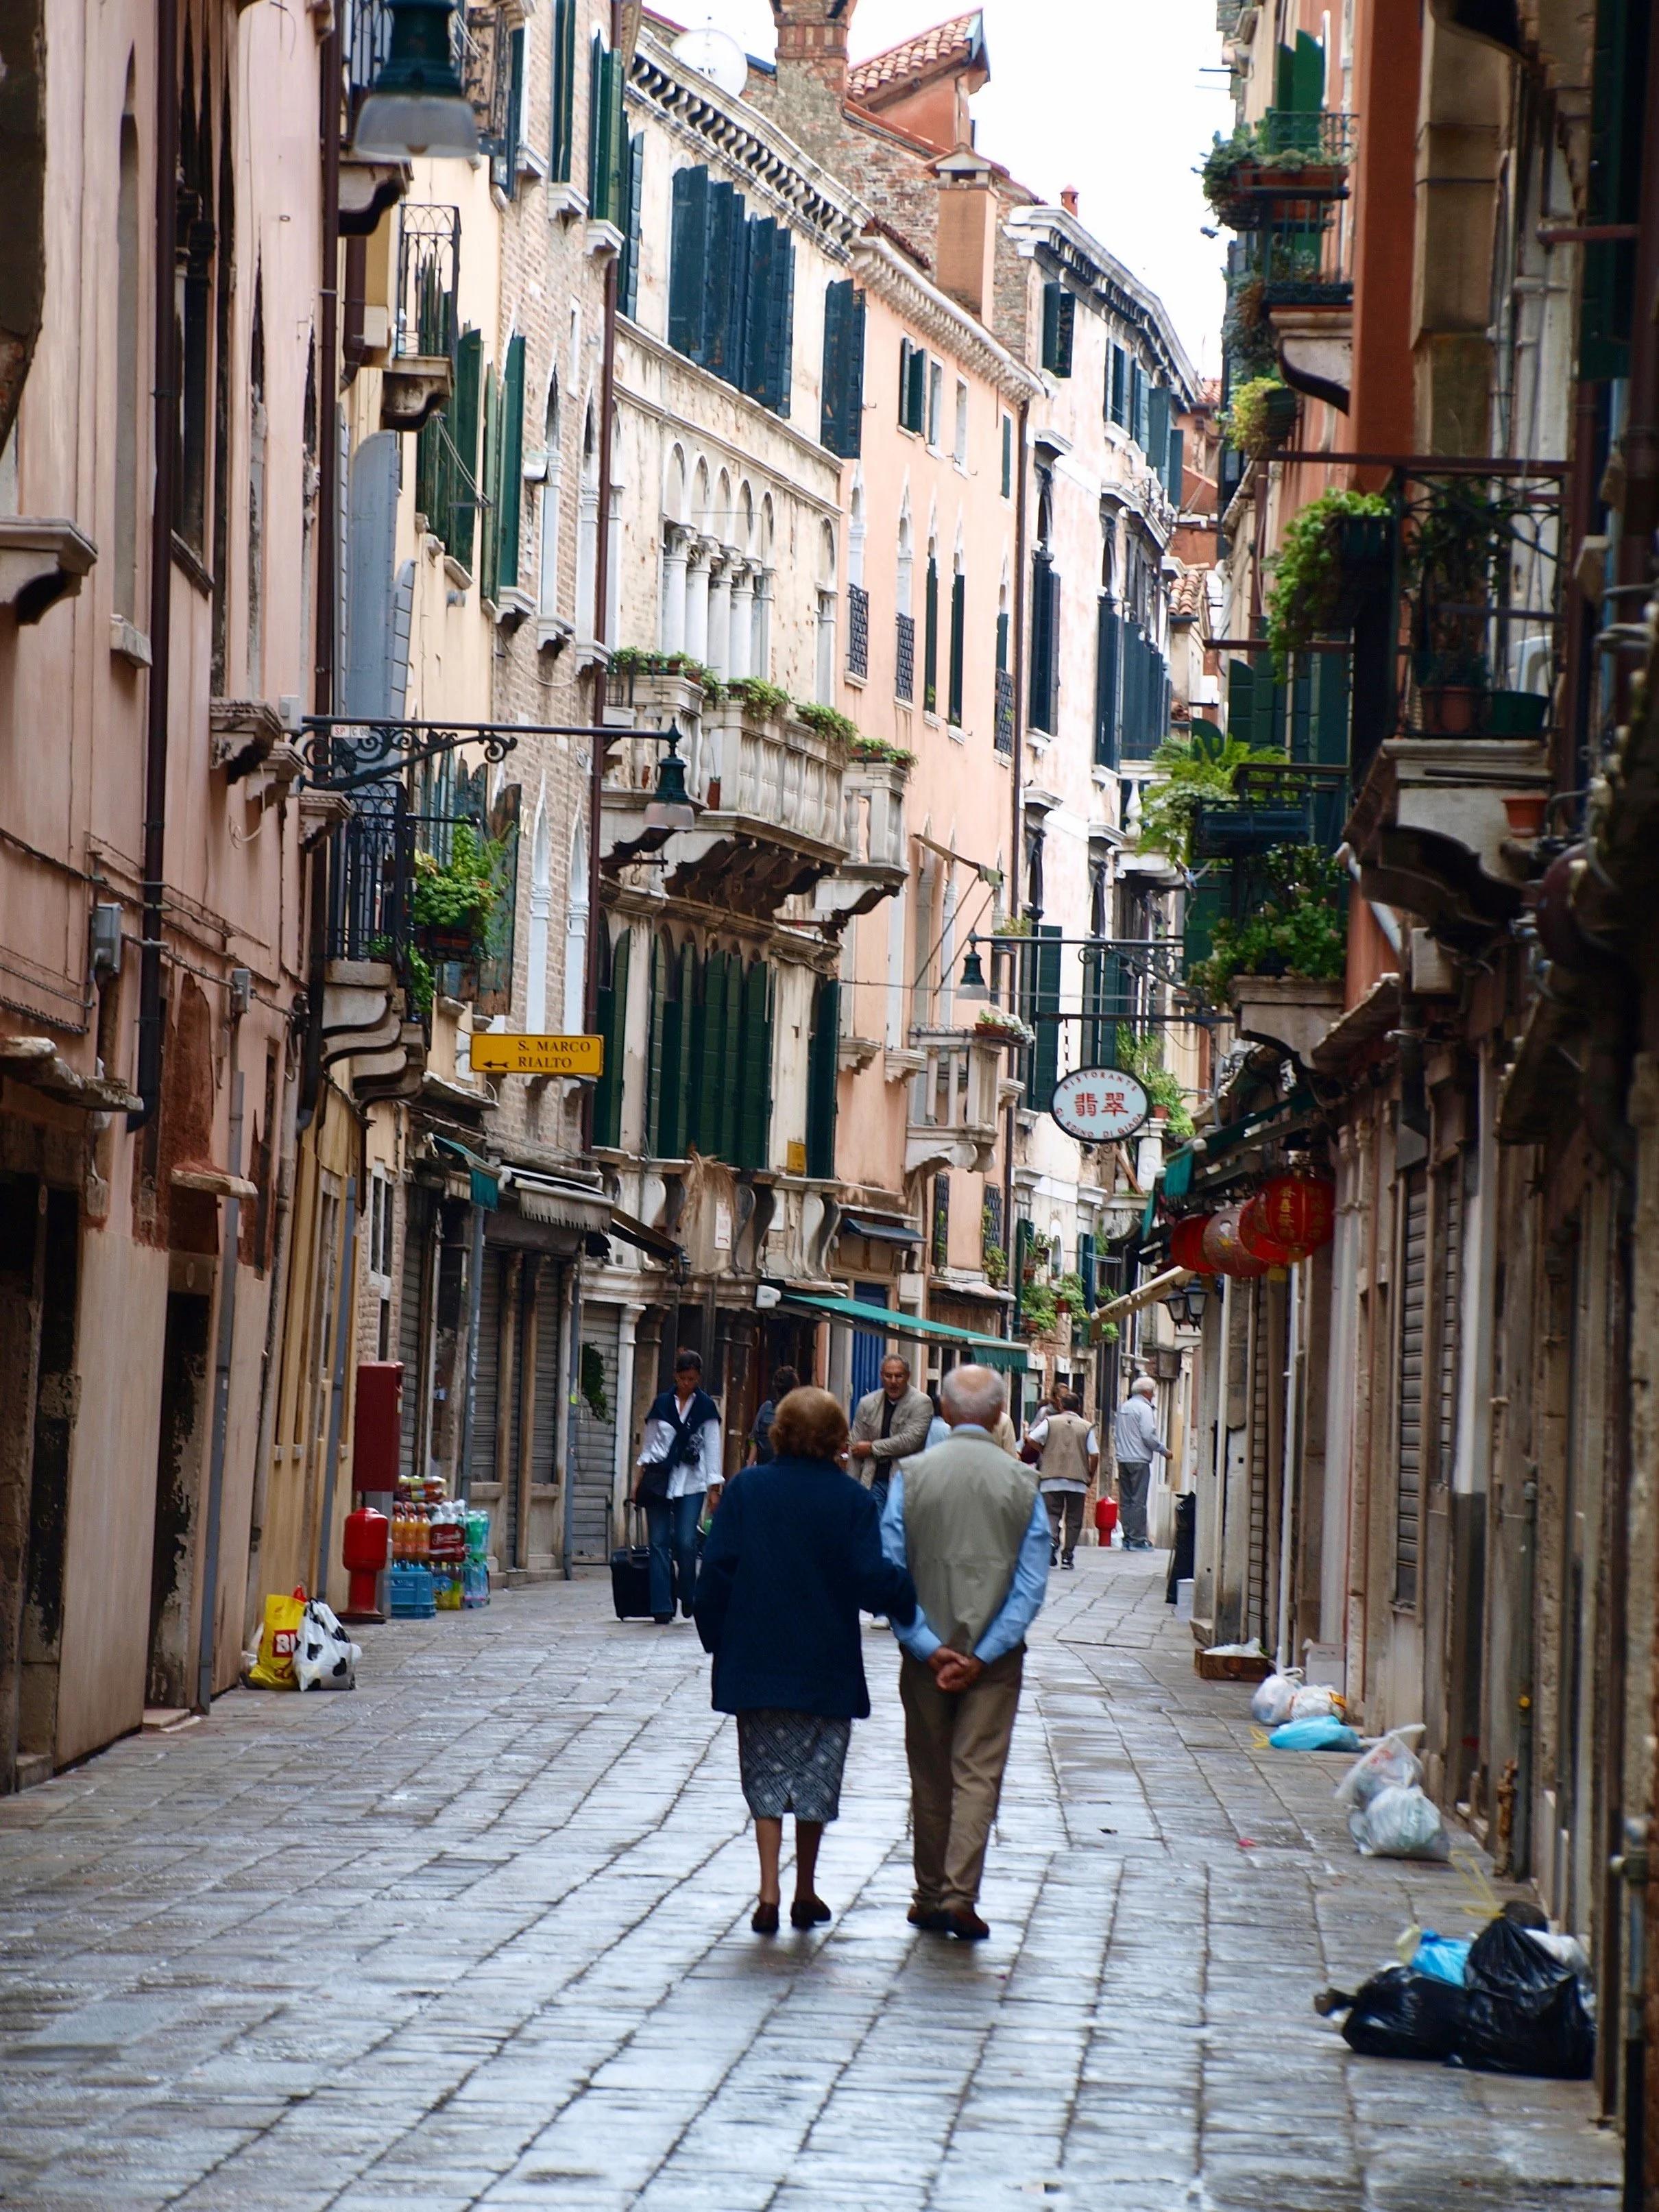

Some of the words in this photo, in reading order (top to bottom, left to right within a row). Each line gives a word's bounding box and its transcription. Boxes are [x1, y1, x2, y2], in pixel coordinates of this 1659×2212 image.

[518, 1040, 530, 1051] S.
[537, 1041, 591, 1053] MARCO
[518, 1056, 572, 1068] RIALTO
[1063, 1071, 1138, 1092] RISTORANTE
[1074, 1092, 1129, 1117] 翡翠
